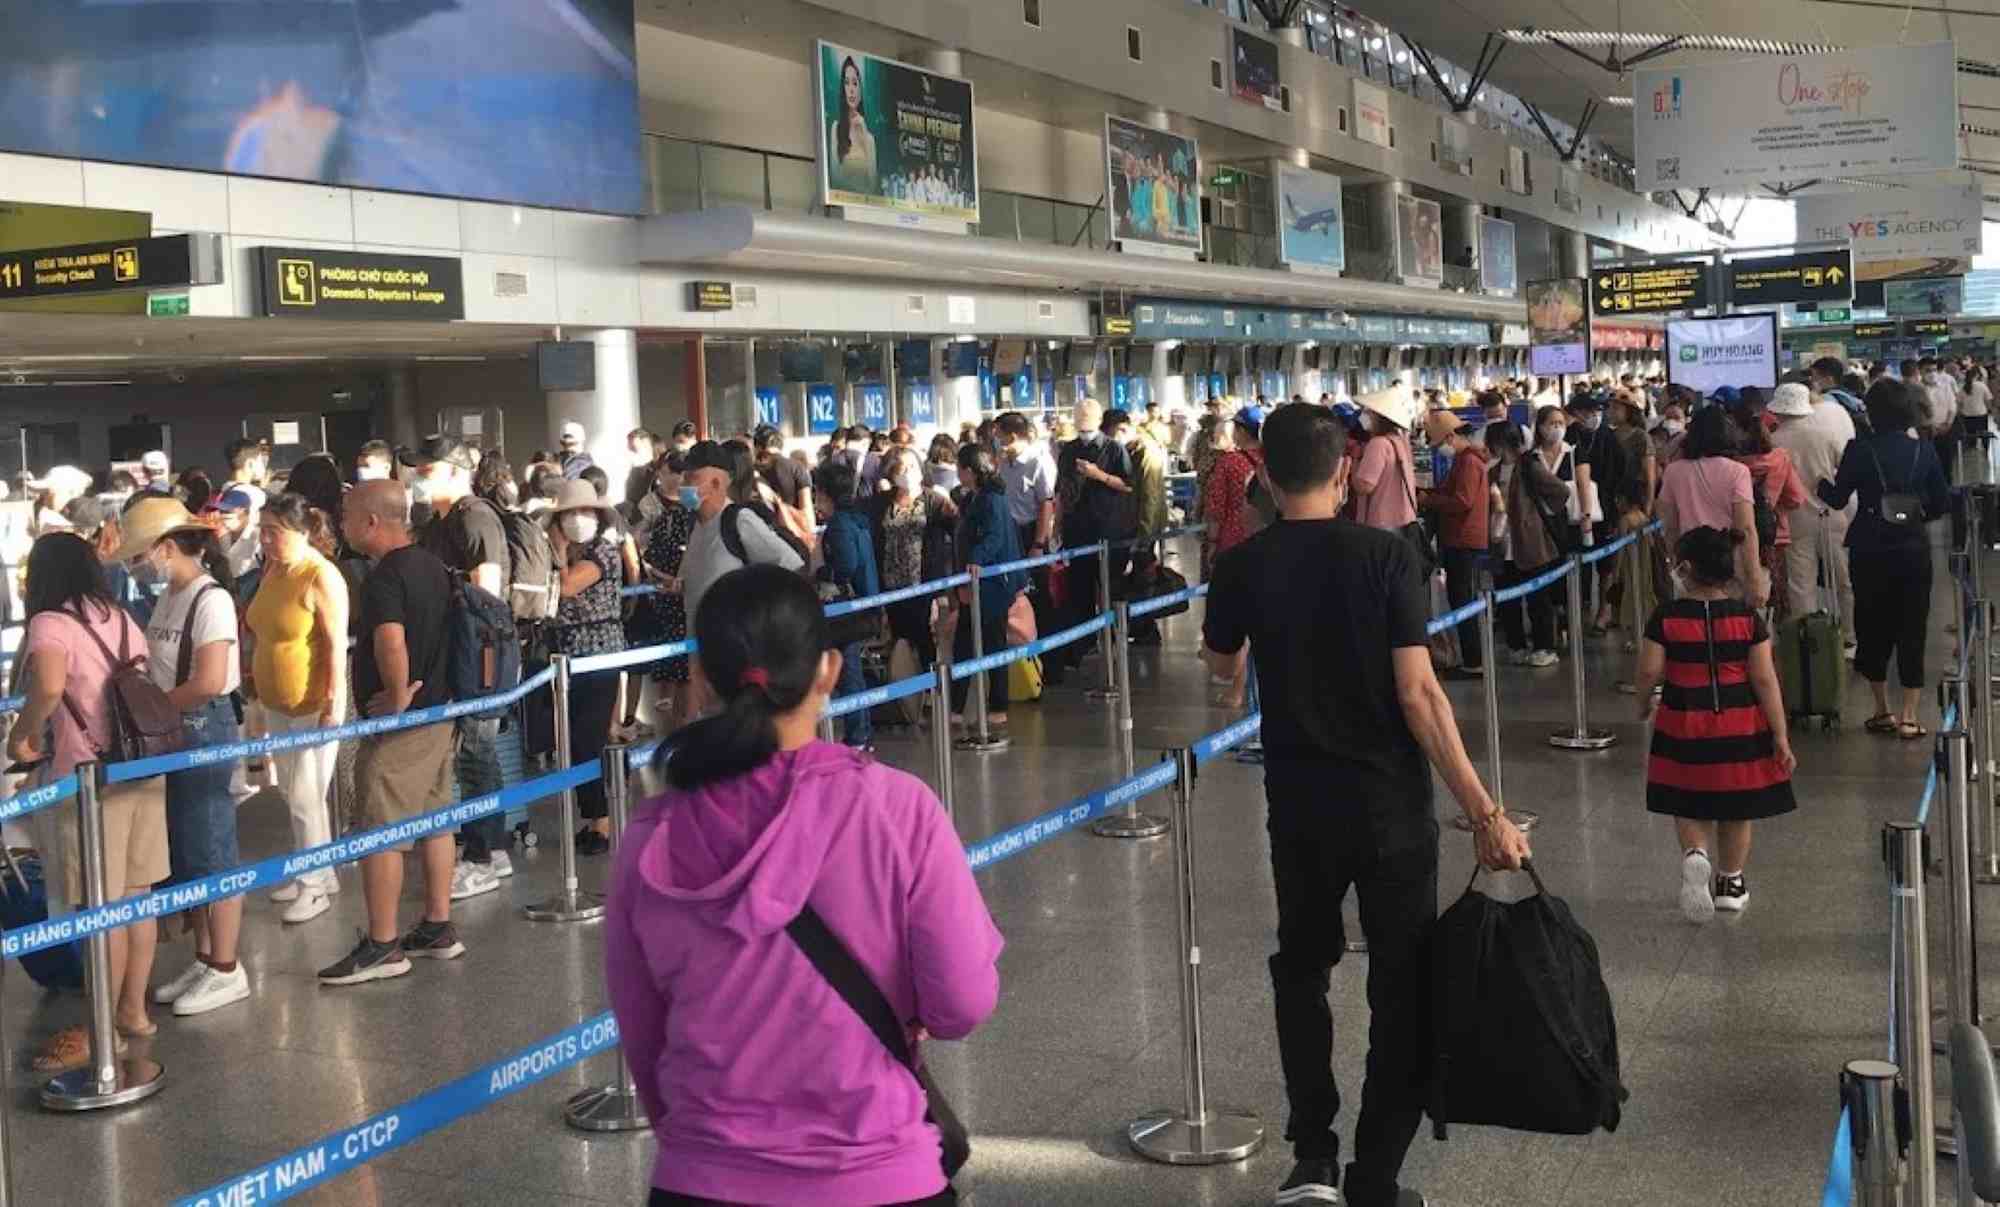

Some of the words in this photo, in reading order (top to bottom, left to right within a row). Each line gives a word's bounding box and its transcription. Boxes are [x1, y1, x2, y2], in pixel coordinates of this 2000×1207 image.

[1815, 226, 1843, 241] THE
[1849, 220, 1889, 239] YES
[1894, 217, 1966, 235] AGENCY
[1, 261, 23, 289] 11
[69, 268, 96, 282] Check
[321, 286, 367, 300] Domestic
[367, 288, 411, 302] Departure
[412, 290, 445, 304] Lounge
[984, 375, 991, 399] 1
[1020, 375, 1029, 398] 2
[1118, 383, 1126, 404] 3
[757, 397, 779, 421] N1
[811, 395, 836, 420] N2
[863, 394, 884, 418] N3
[911, 392, 931, 415] N4
[407, 711, 430, 726] CTCP
[29, 785, 60, 806] CTCP
[283, 843, 347, 876] AIRPORTS
[349, 815, 433, 855] CORPORATION
[433, 811, 449, 828] OF
[451, 795, 500, 824] VIETNAM
[992, 832, 1024, 856] KHÔNG
[1023, 821, 1044, 846] VIỆT
[1043, 813, 1065, 834] NAM
[1069, 802, 1091, 824] CTCP
[22, 922, 73, 949] HÀNG
[75, 905, 133, 934] KHÔNG
[135, 891, 170, 917] VIỆT
[172, 883, 209, 908] NAM
[219, 870, 258, 894] CTCP
[489, 1035, 577, 1095] AIRPORTS
[580, 1017, 620, 1051] COR
[274, 1147, 326, 1192] NAM
[343, 1114, 400, 1160] CTCP
